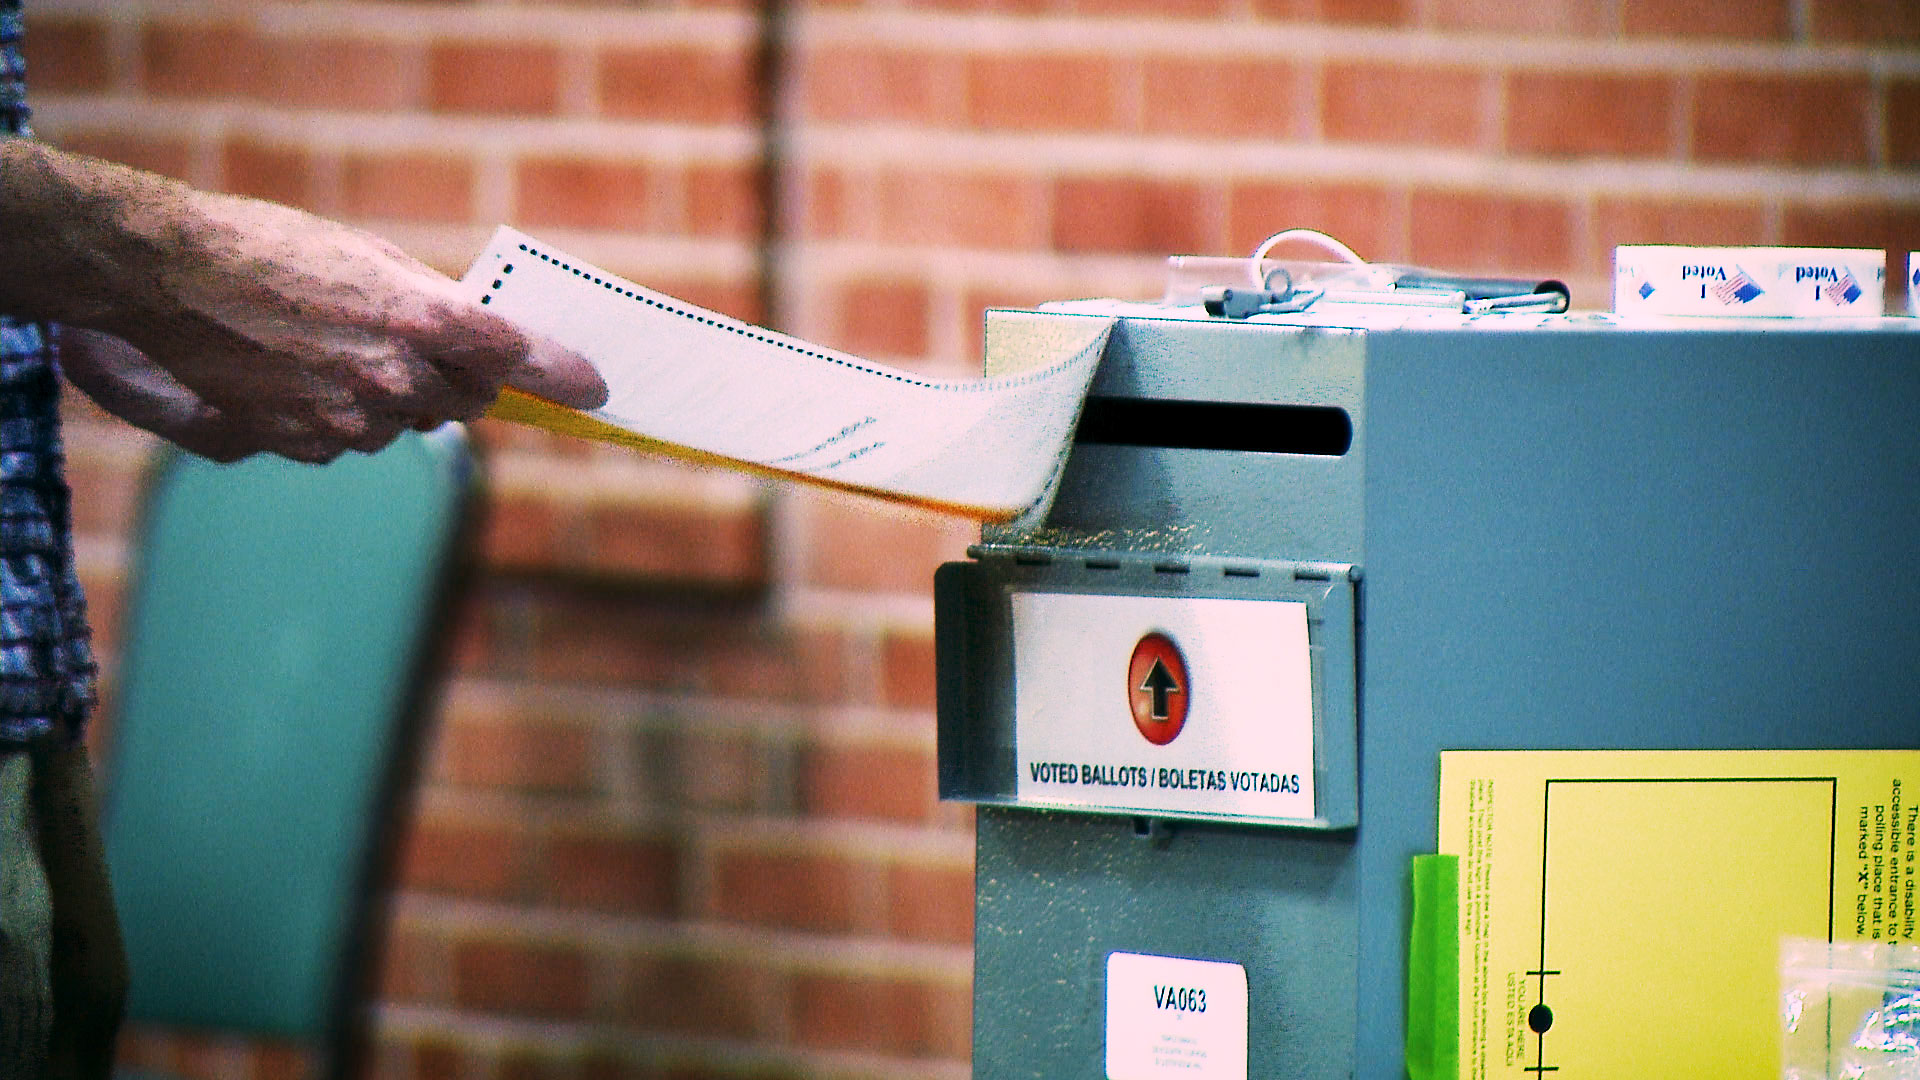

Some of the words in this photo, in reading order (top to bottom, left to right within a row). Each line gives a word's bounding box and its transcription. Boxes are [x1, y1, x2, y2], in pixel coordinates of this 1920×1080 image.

[1682, 264, 1727, 281] Voted
[1795, 266, 1838, 283] Voted
[1700, 283, 1706, 299] I
[1815, 285, 1821, 301] I
[1030, 762, 1078, 784] VOTED
[1081, 765, 1147, 788] BALLOTS
[1159, 768, 1226, 791] BOLETAS
[1230, 772, 1300, 794] VOTADAS
[1872, 805, 1886, 851] polling
[1890, 778, 1901, 853] accessible
[1906, 804, 1919, 846] There
[1858, 806, 1869, 859] marked
[1906, 850, 1915, 862] is
[1872, 855, 1885, 893] place
[1905, 866, 1914, 875] a
[1888, 857, 1899, 918] entrance
[1872, 897, 1883, 925] that
[1902, 879, 1915, 938] disability
[1872, 929, 1881, 939] is
[1887, 923, 1898, 936] to
[1153, 985, 1207, 1013] VA063
